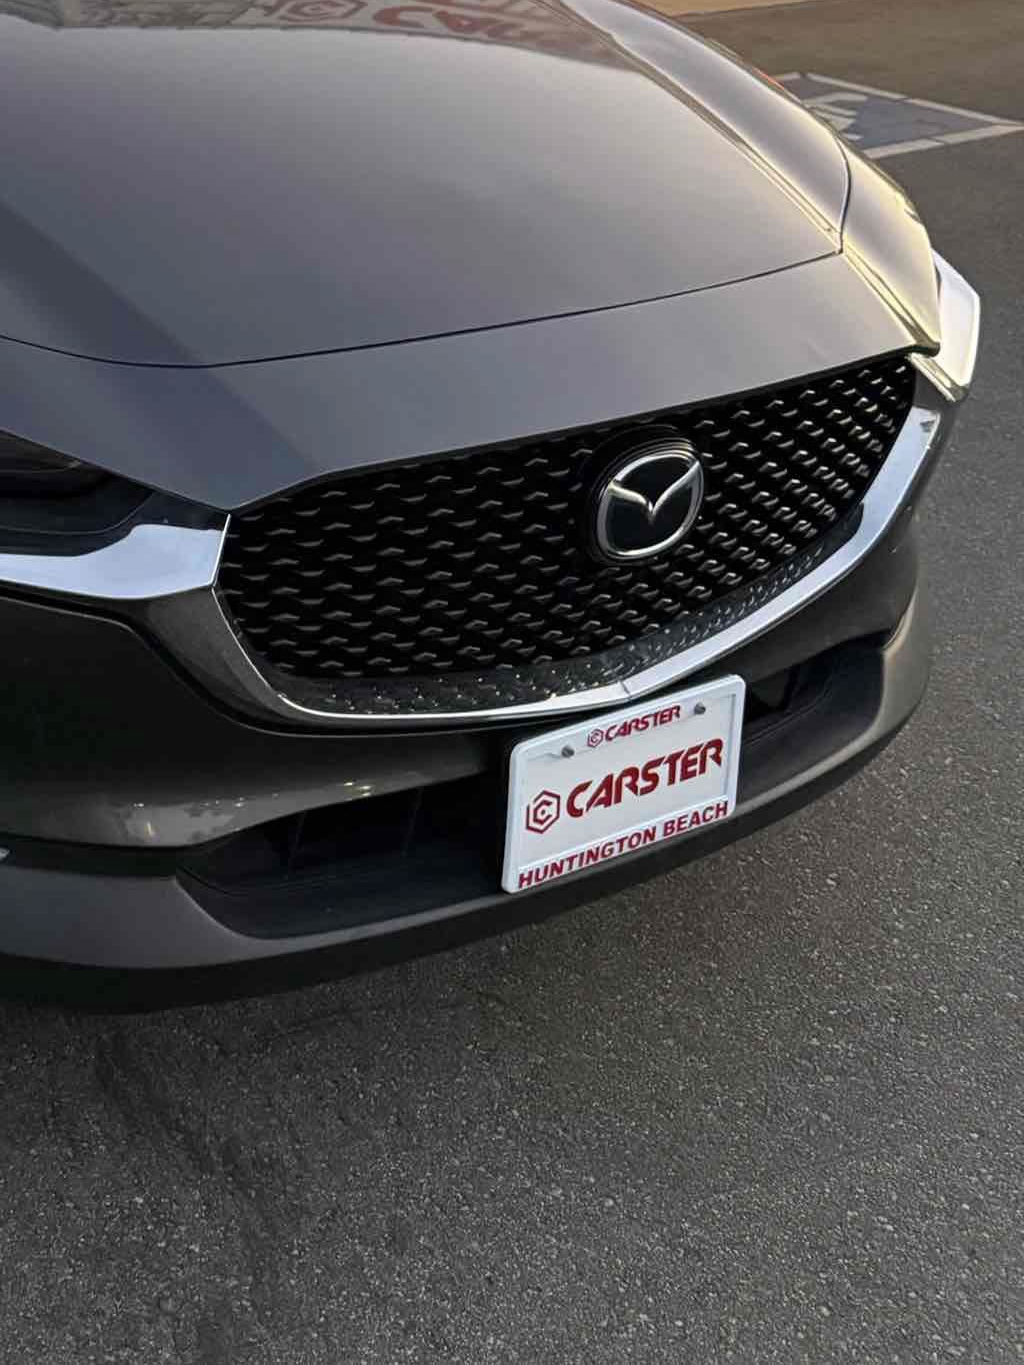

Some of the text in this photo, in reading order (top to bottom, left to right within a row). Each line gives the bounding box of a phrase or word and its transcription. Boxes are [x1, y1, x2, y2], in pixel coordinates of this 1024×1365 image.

[605, 705, 681, 742] CARSTER
[566, 738, 724, 818] CARSTER
[518, 800, 729, 889] HUNTINGTON BEACH
